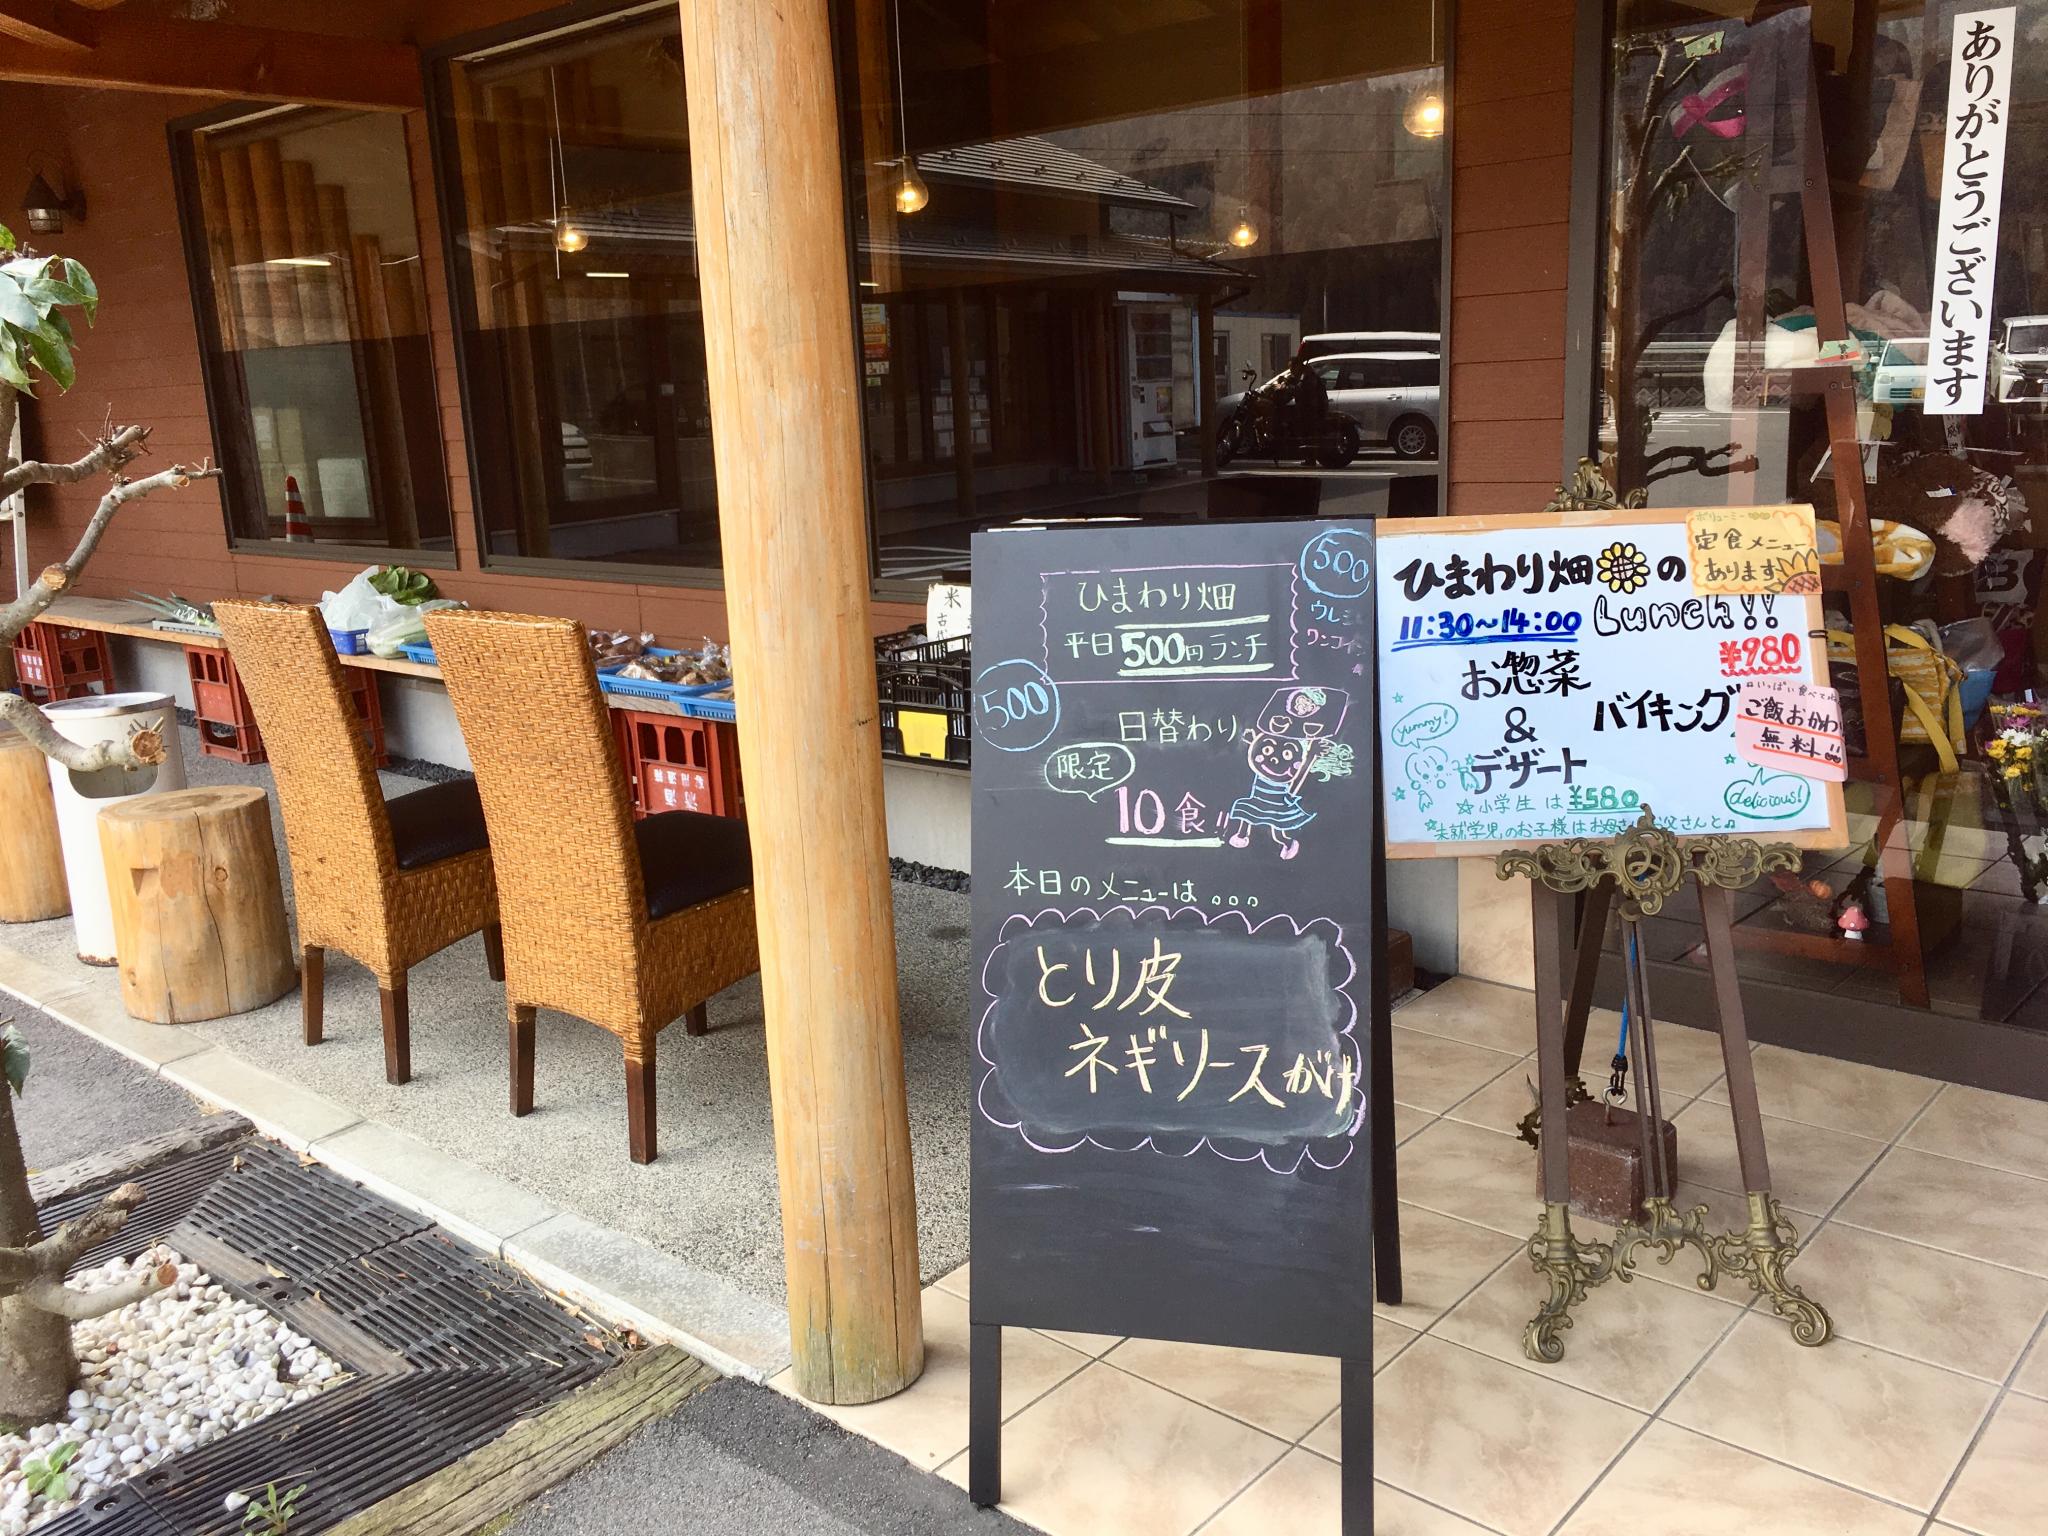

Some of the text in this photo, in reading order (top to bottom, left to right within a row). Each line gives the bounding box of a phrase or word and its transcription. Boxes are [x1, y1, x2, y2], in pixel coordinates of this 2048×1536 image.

[1934, 20, 2001, 407] ありがとうございます
[1313, 537, 1369, 583] 500
[1694, 528, 1807, 551] 定食メニュー
[1393, 550, 1686, 601] ひまわり畑 の
[1703, 557, 1776, 582] あります
[1077, 577, 1236, 614] ひまわり畑
[1719, 633, 1801, 669] ¥980
[1461, 649, 1592, 701] お惣菜
[982, 681, 1050, 732] 500
[1118, 707, 1238, 743] 日替わり
[1504, 707, 1538, 743] &
[1593, 683, 1741, 732] バイキング
[1057, 752, 1115, 780] 限定
[1471, 746, 1587, 795] デザート
[1568, 785, 1639, 809] ¥580
[1036, 937, 1192, 1019] とり皮
